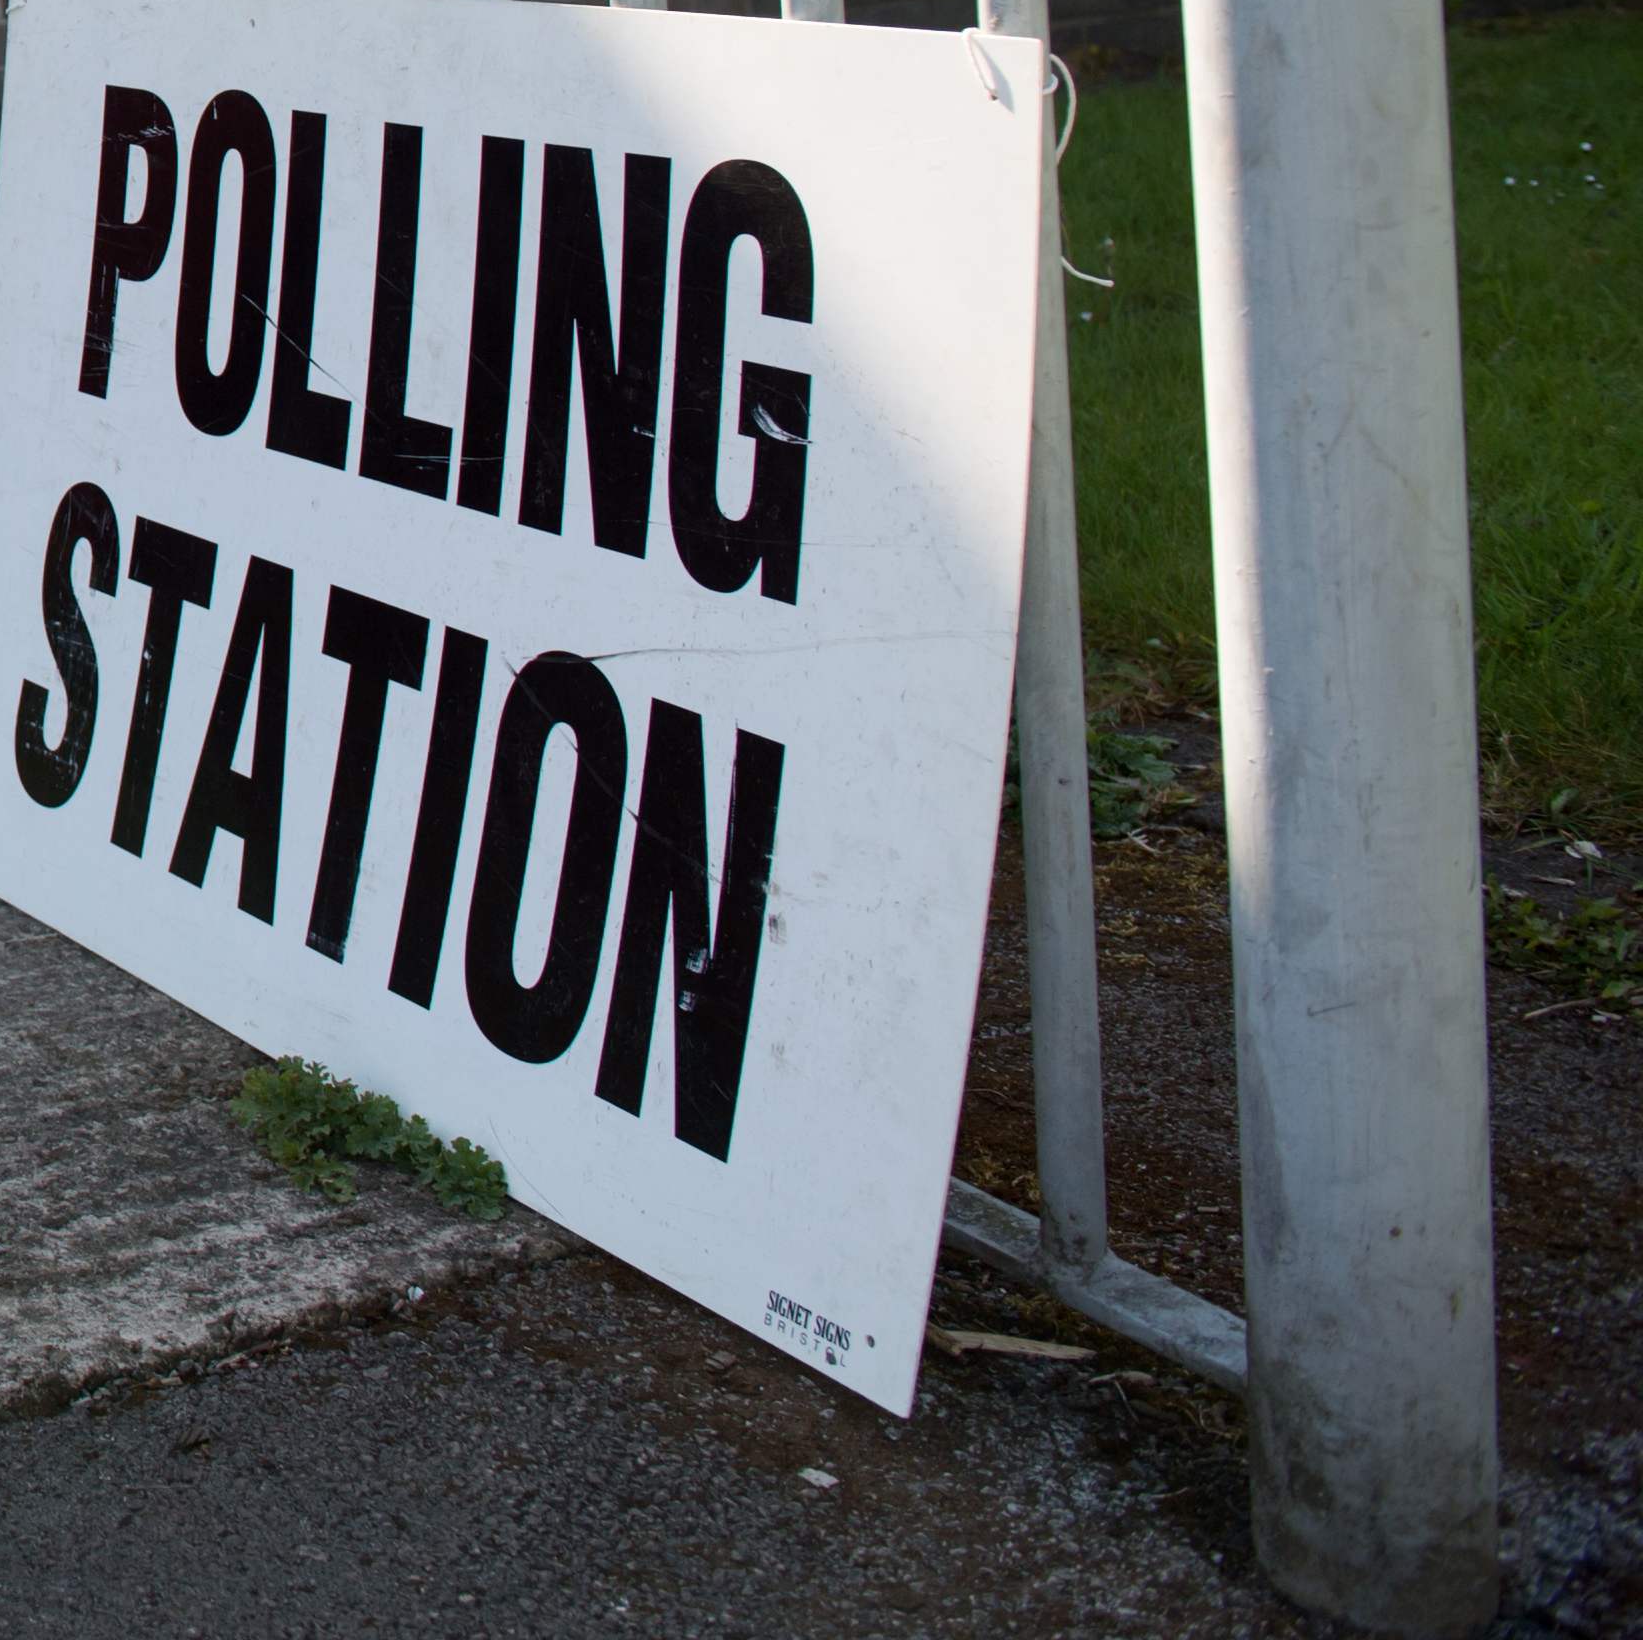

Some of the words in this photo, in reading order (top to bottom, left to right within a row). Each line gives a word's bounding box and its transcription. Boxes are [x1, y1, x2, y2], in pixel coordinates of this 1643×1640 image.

[79, 84, 814, 606] POLLING
[15, 482, 785, 1163] STATION
[766, 1289, 813, 1330] SIGNET
[813, 1314, 851, 1352] SIGNS
